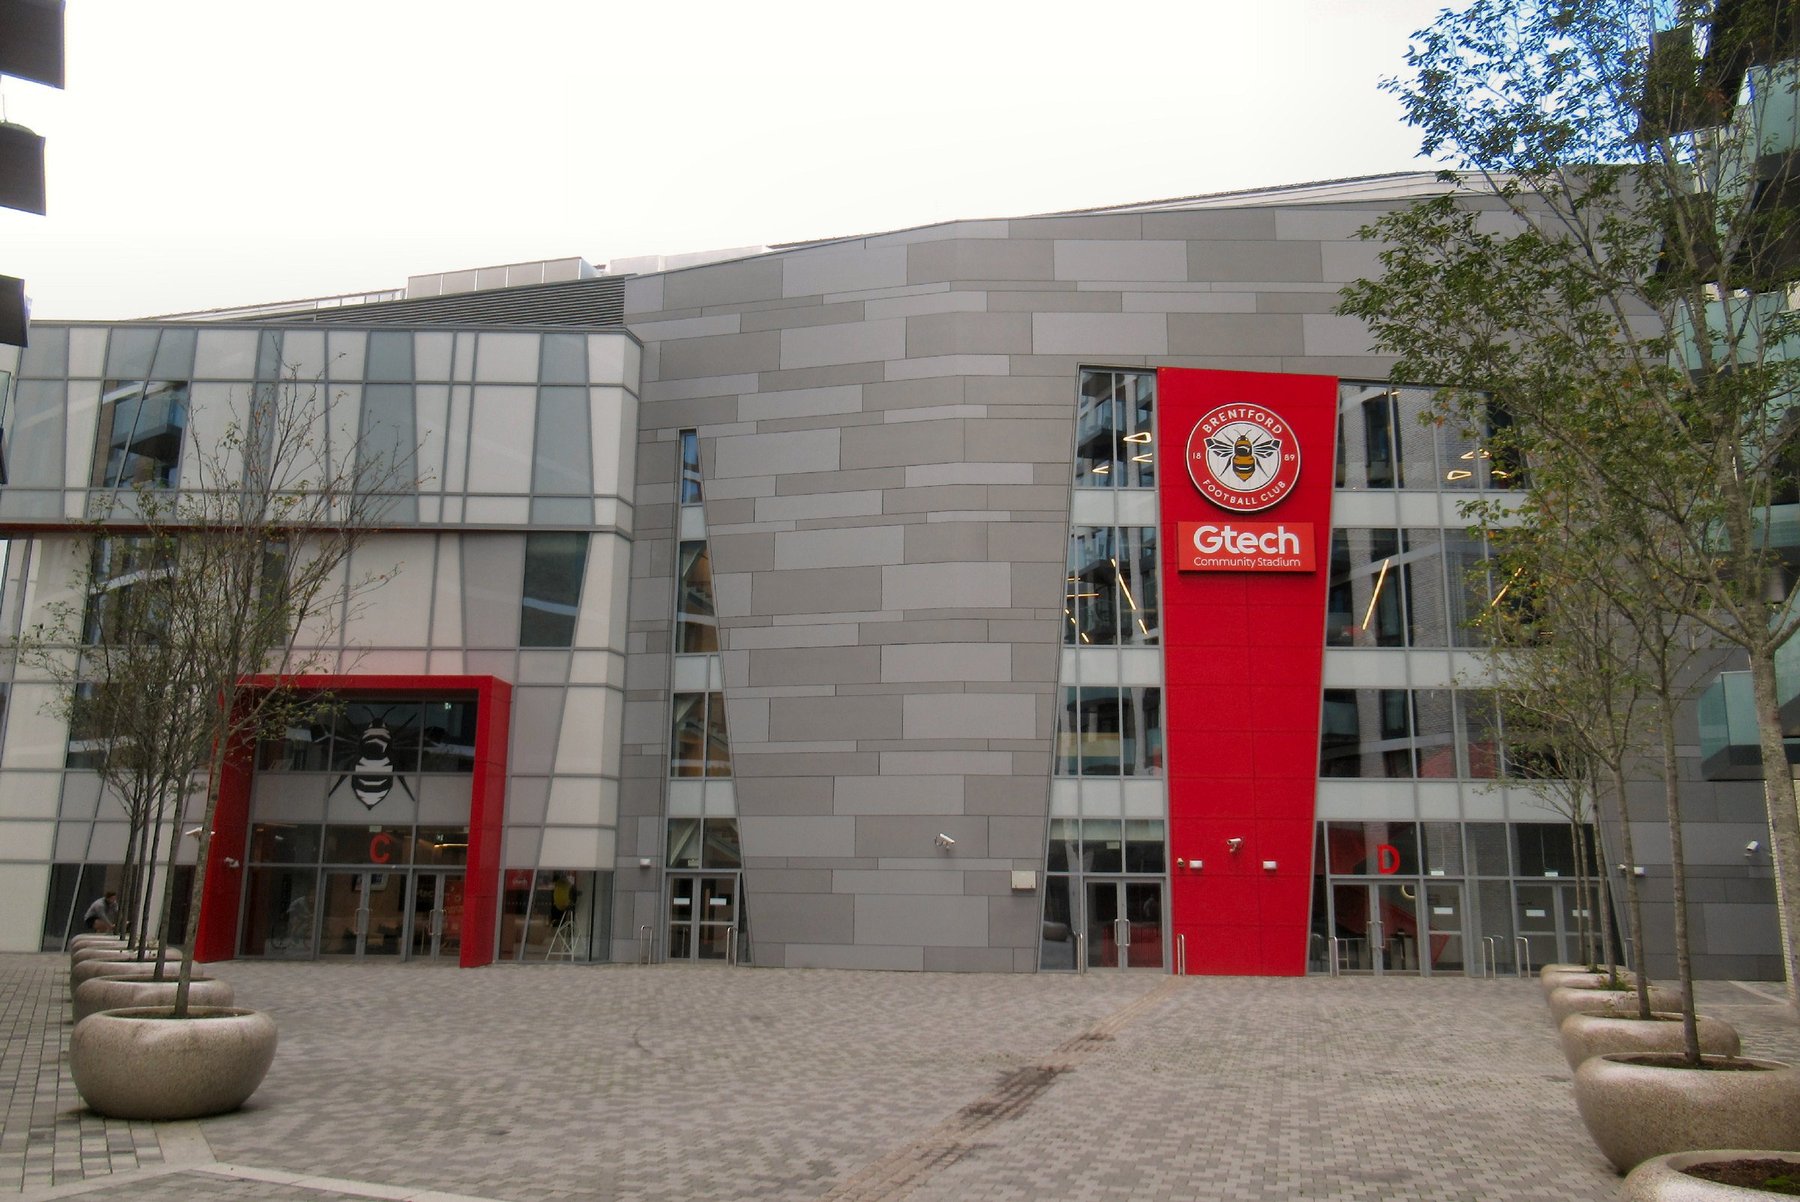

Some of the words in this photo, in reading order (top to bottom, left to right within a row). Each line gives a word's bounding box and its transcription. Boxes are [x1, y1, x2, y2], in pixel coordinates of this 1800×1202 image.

[1202, 408, 1282, 434] BRENTFORD
[1192, 452, 1201, 460] 18
[1202, 479, 1257, 505] FOOTBALL
[1260, 481, 1286, 502] CLUB
[1193, 525, 1300, 554] Gtech
[1193, 556, 1256, 569] Community
[1257, 557, 1300, 567] Stadium
[370, 832, 391, 864] C
[1377, 844, 1400, 875] D
